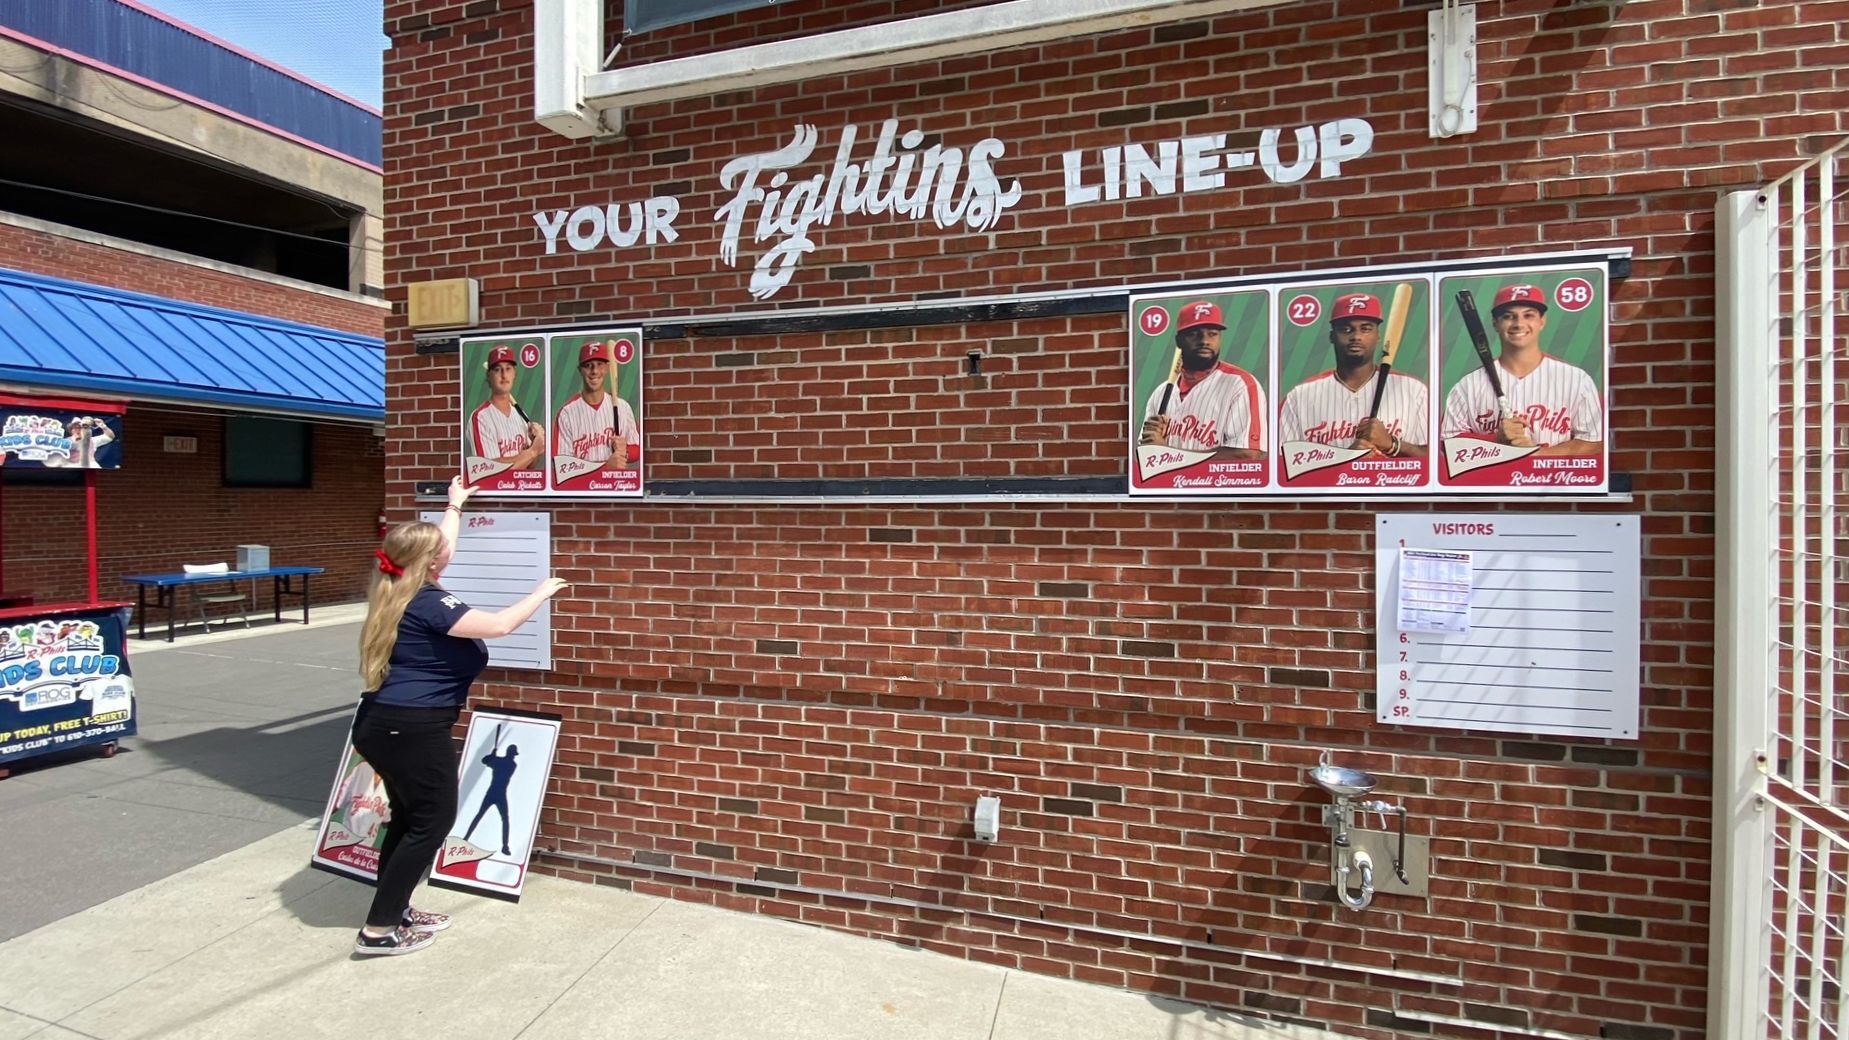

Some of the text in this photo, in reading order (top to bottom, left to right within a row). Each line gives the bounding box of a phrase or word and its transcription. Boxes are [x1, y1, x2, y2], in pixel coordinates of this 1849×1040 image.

[532, 117, 1375, 300] YOUR Fightins LINE-UP
[1561, 286, 1588, 304] 58
[1293, 303, 1316, 319] 22
[1146, 313, 1163, 329] 19
[525, 350, 535, 362] 16
[619, 345, 627, 357] 8
[1146, 452, 1184, 468] R-Phils
[1292, 449, 1335, 465] R-Phils
[1455, 447, 1501, 463] R-Phils
[1208, 463, 1262, 473] INFIELDER
[1351, 460, 1422, 471] OUTFIELDER
[1533, 459, 1598, 469] INFIELDER
[1173, 474, 1262, 488] Kendall Simmons
[1336, 473, 1422, 486] Baron Radcliff
[1510, 471, 1597, 486] Robert Moore
[1433, 523, 1494, 536] VISITORS
[1399, 632, 1410, 643] 6.
[1399, 651, 1408, 662] 7.
[50, 655, 118, 676] CLUB
[1399, 670, 1410, 680] 8.
[1399, 688, 1410, 699] 9.
[1392, 705, 1409, 717] SP.
[14, 725, 51, 739] TODAY,
[53, 719, 81, 732] FREE
